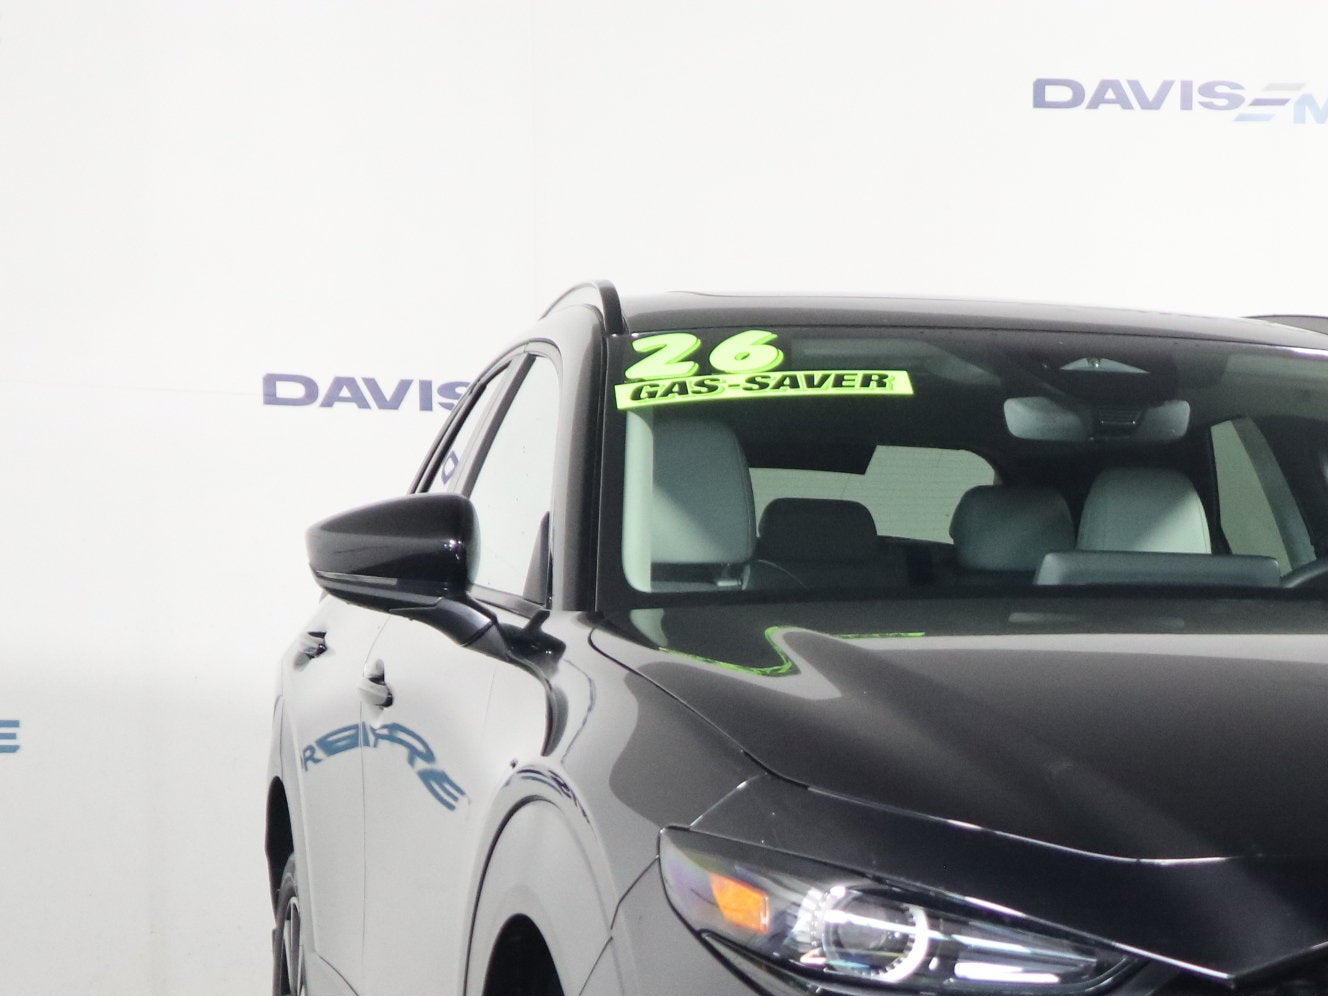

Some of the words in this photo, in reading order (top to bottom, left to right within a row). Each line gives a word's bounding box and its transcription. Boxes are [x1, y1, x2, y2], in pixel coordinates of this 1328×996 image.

[1032, 78, 1246, 111] DAVIS
[625, 329, 784, 381] 26
[629, 372, 891, 401] GAS-SAVER
